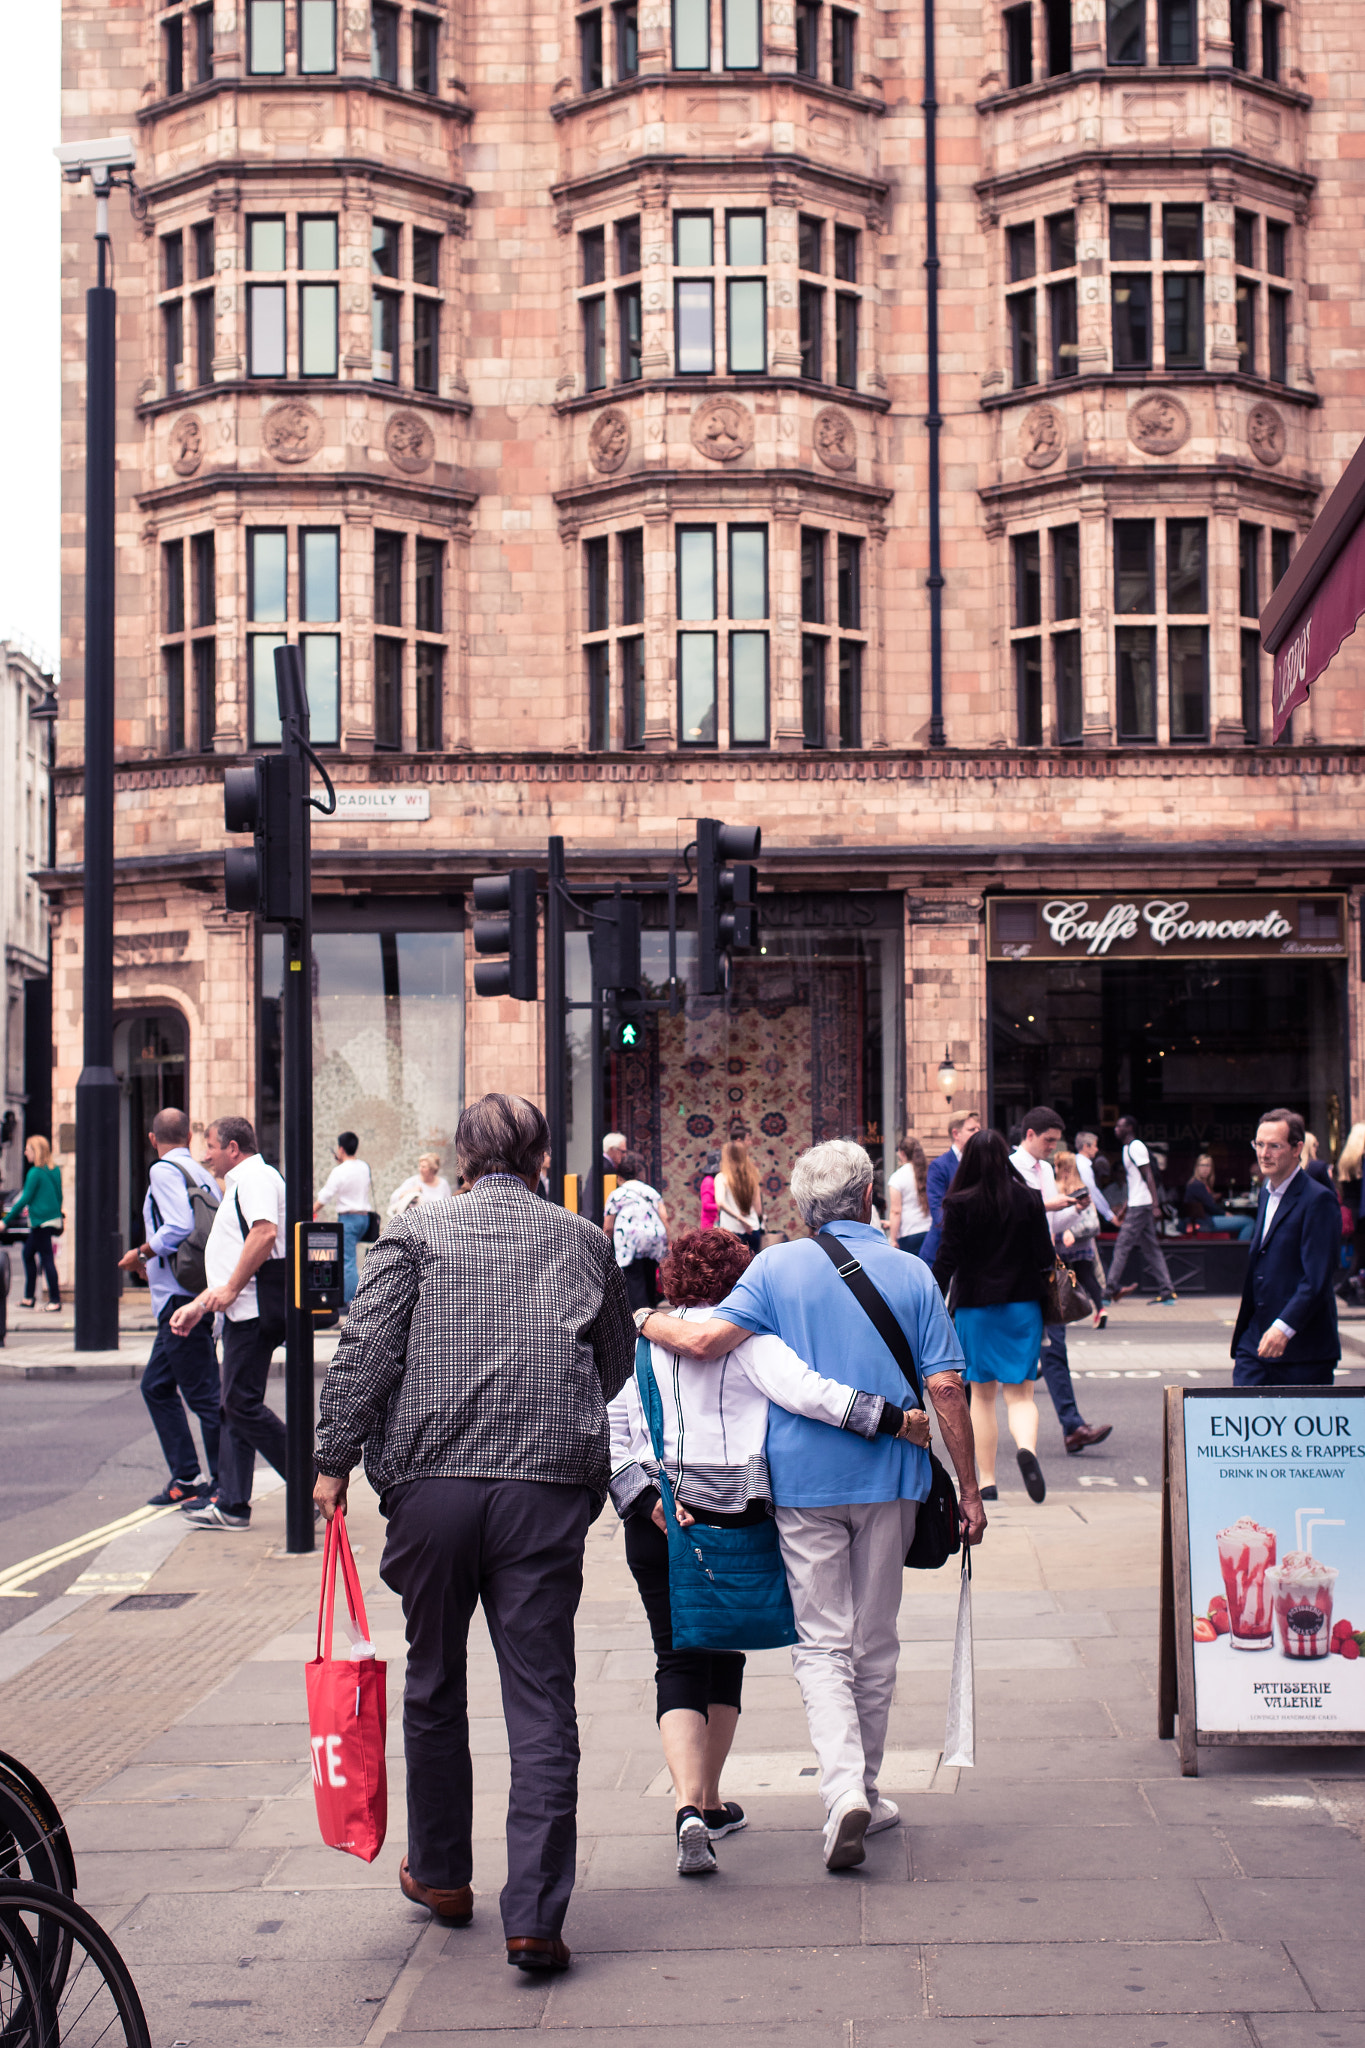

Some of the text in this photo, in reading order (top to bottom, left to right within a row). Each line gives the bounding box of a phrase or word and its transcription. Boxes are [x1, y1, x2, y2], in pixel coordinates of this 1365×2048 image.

[314, 795, 423, 805] PICADILLY W1
[1143, 900, 1292, 945] Concerto
[309, 1249, 335, 1261] WAIT
[1211, 1415, 1352, 1442] ENJOY OUR
[1197, 1445, 1365, 1458] MILKSHAKES & FRAPPES
[1219, 1469, 1346, 1479] DRINK IN OR TAKEAWAY
[1253, 1682, 1332, 1694] PATISSERIE
[1263, 1697, 1323, 1708] VALERIE
[311, 1734, 348, 1788] TE
